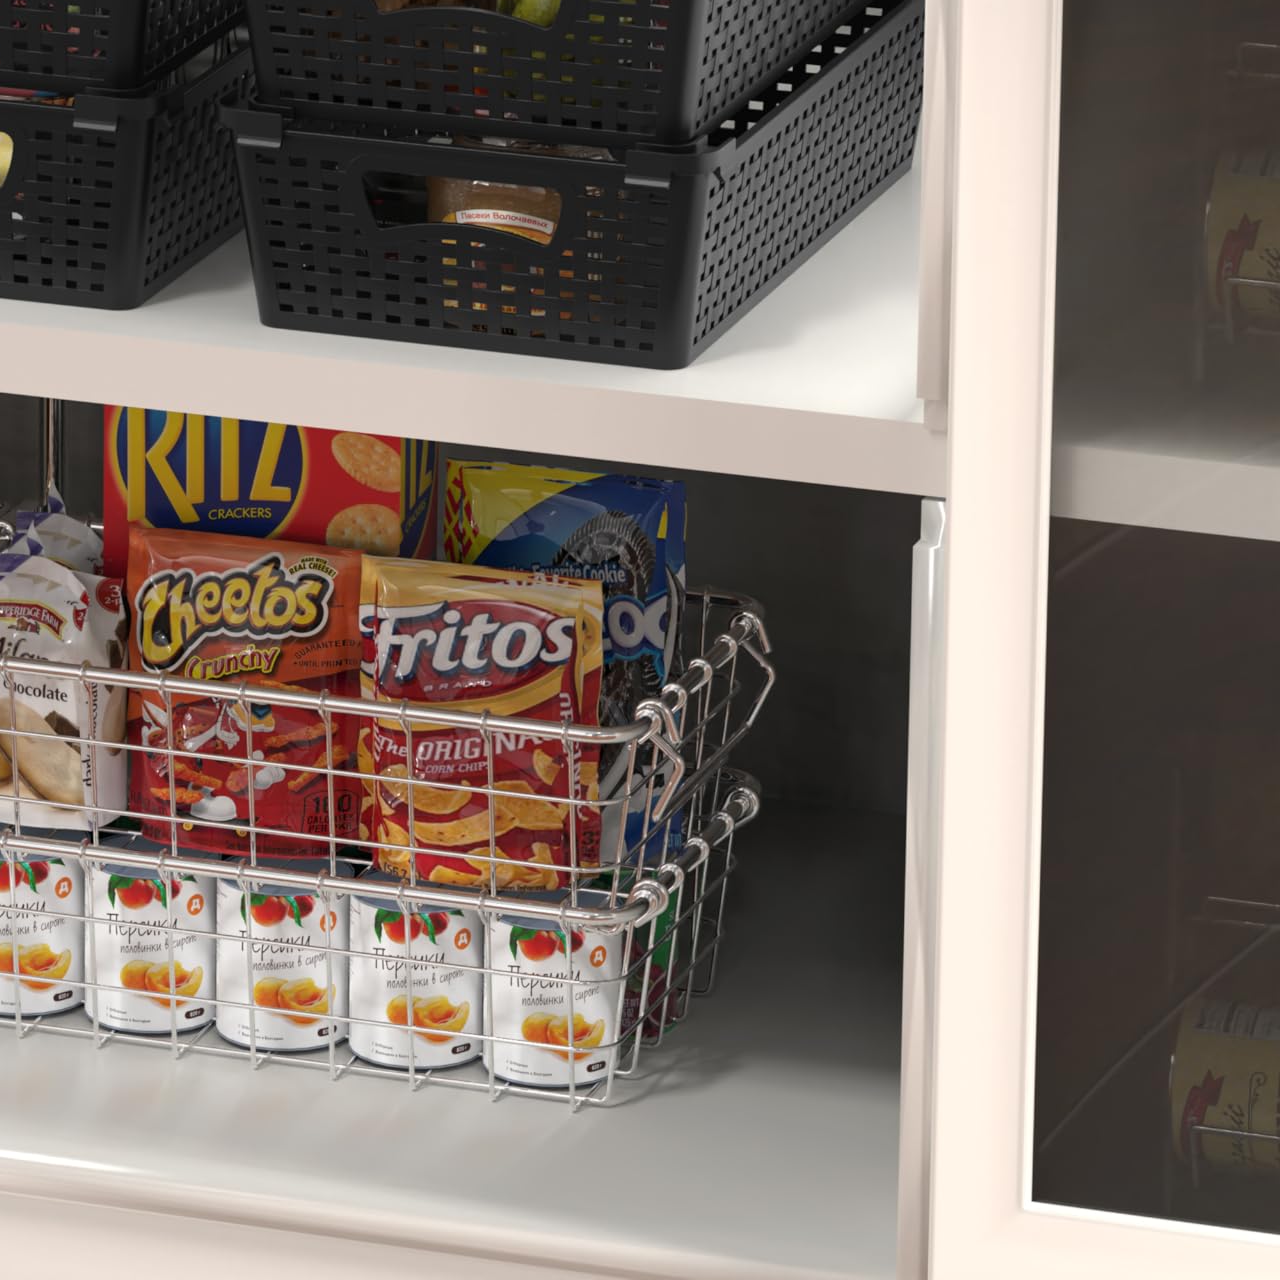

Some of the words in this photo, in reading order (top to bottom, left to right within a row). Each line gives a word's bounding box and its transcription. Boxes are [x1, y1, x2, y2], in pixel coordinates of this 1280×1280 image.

[128, 406, 292, 524] RITZ
[208, 507, 272, 520] CRACKERS
[289, 563, 307, 575] REAL
[308, 562, 337, 578] CHEESE!
[41, 610, 60, 630] FARM
[140, 557, 326, 667] Cheetos
[376, 600, 577, 678] Fritos
[294, 640, 356, 660] GUARANTEED
[186, 644, 280, 680] Crunchy
[424, 680, 492, 693] BRAND
[379, 736, 407, 757] The
[417, 732, 555, 761] ORIGNA
[425, 764, 454, 774] CORN
[305, 952, 327, 968] сироп
[387, 976, 428, 988] половнки
[522, 994, 564, 1006] половинки
